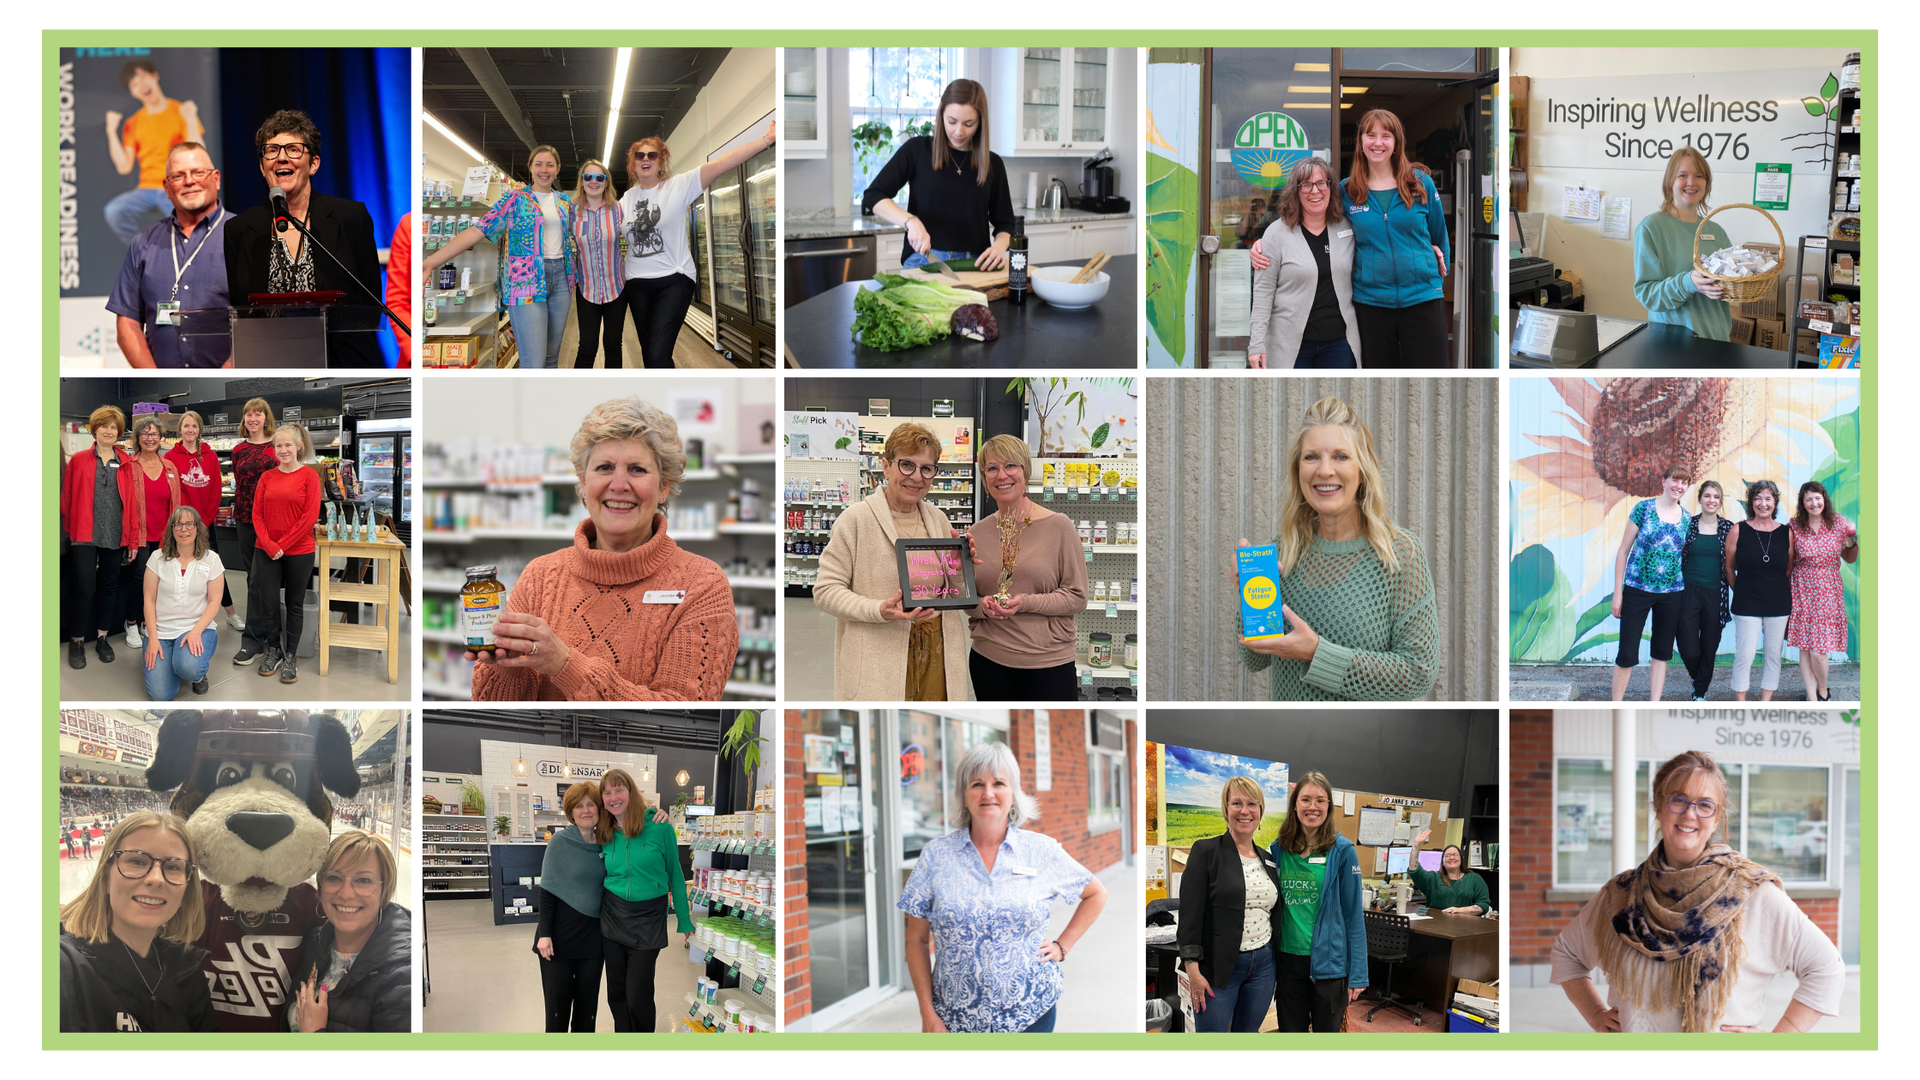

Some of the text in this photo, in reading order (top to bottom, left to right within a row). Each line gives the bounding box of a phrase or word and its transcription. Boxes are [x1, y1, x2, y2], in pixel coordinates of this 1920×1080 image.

[1547, 94, 1780, 130] Inspiring Wellness
[1235, 112, 1305, 148] OPEN
[1604, 131, 1673, 160] Since
[60, 61, 79, 290] WORK READINESS
[792, 414, 828, 425] Staff Pick
[909, 551, 959, 566] Wish Ada
[908, 568, 944, 580] Congrats
[911, 583, 960, 597] 30 Years
[1248, 586, 1272, 594] Fatigue
[1715, 727, 1813, 749] Since 1976
